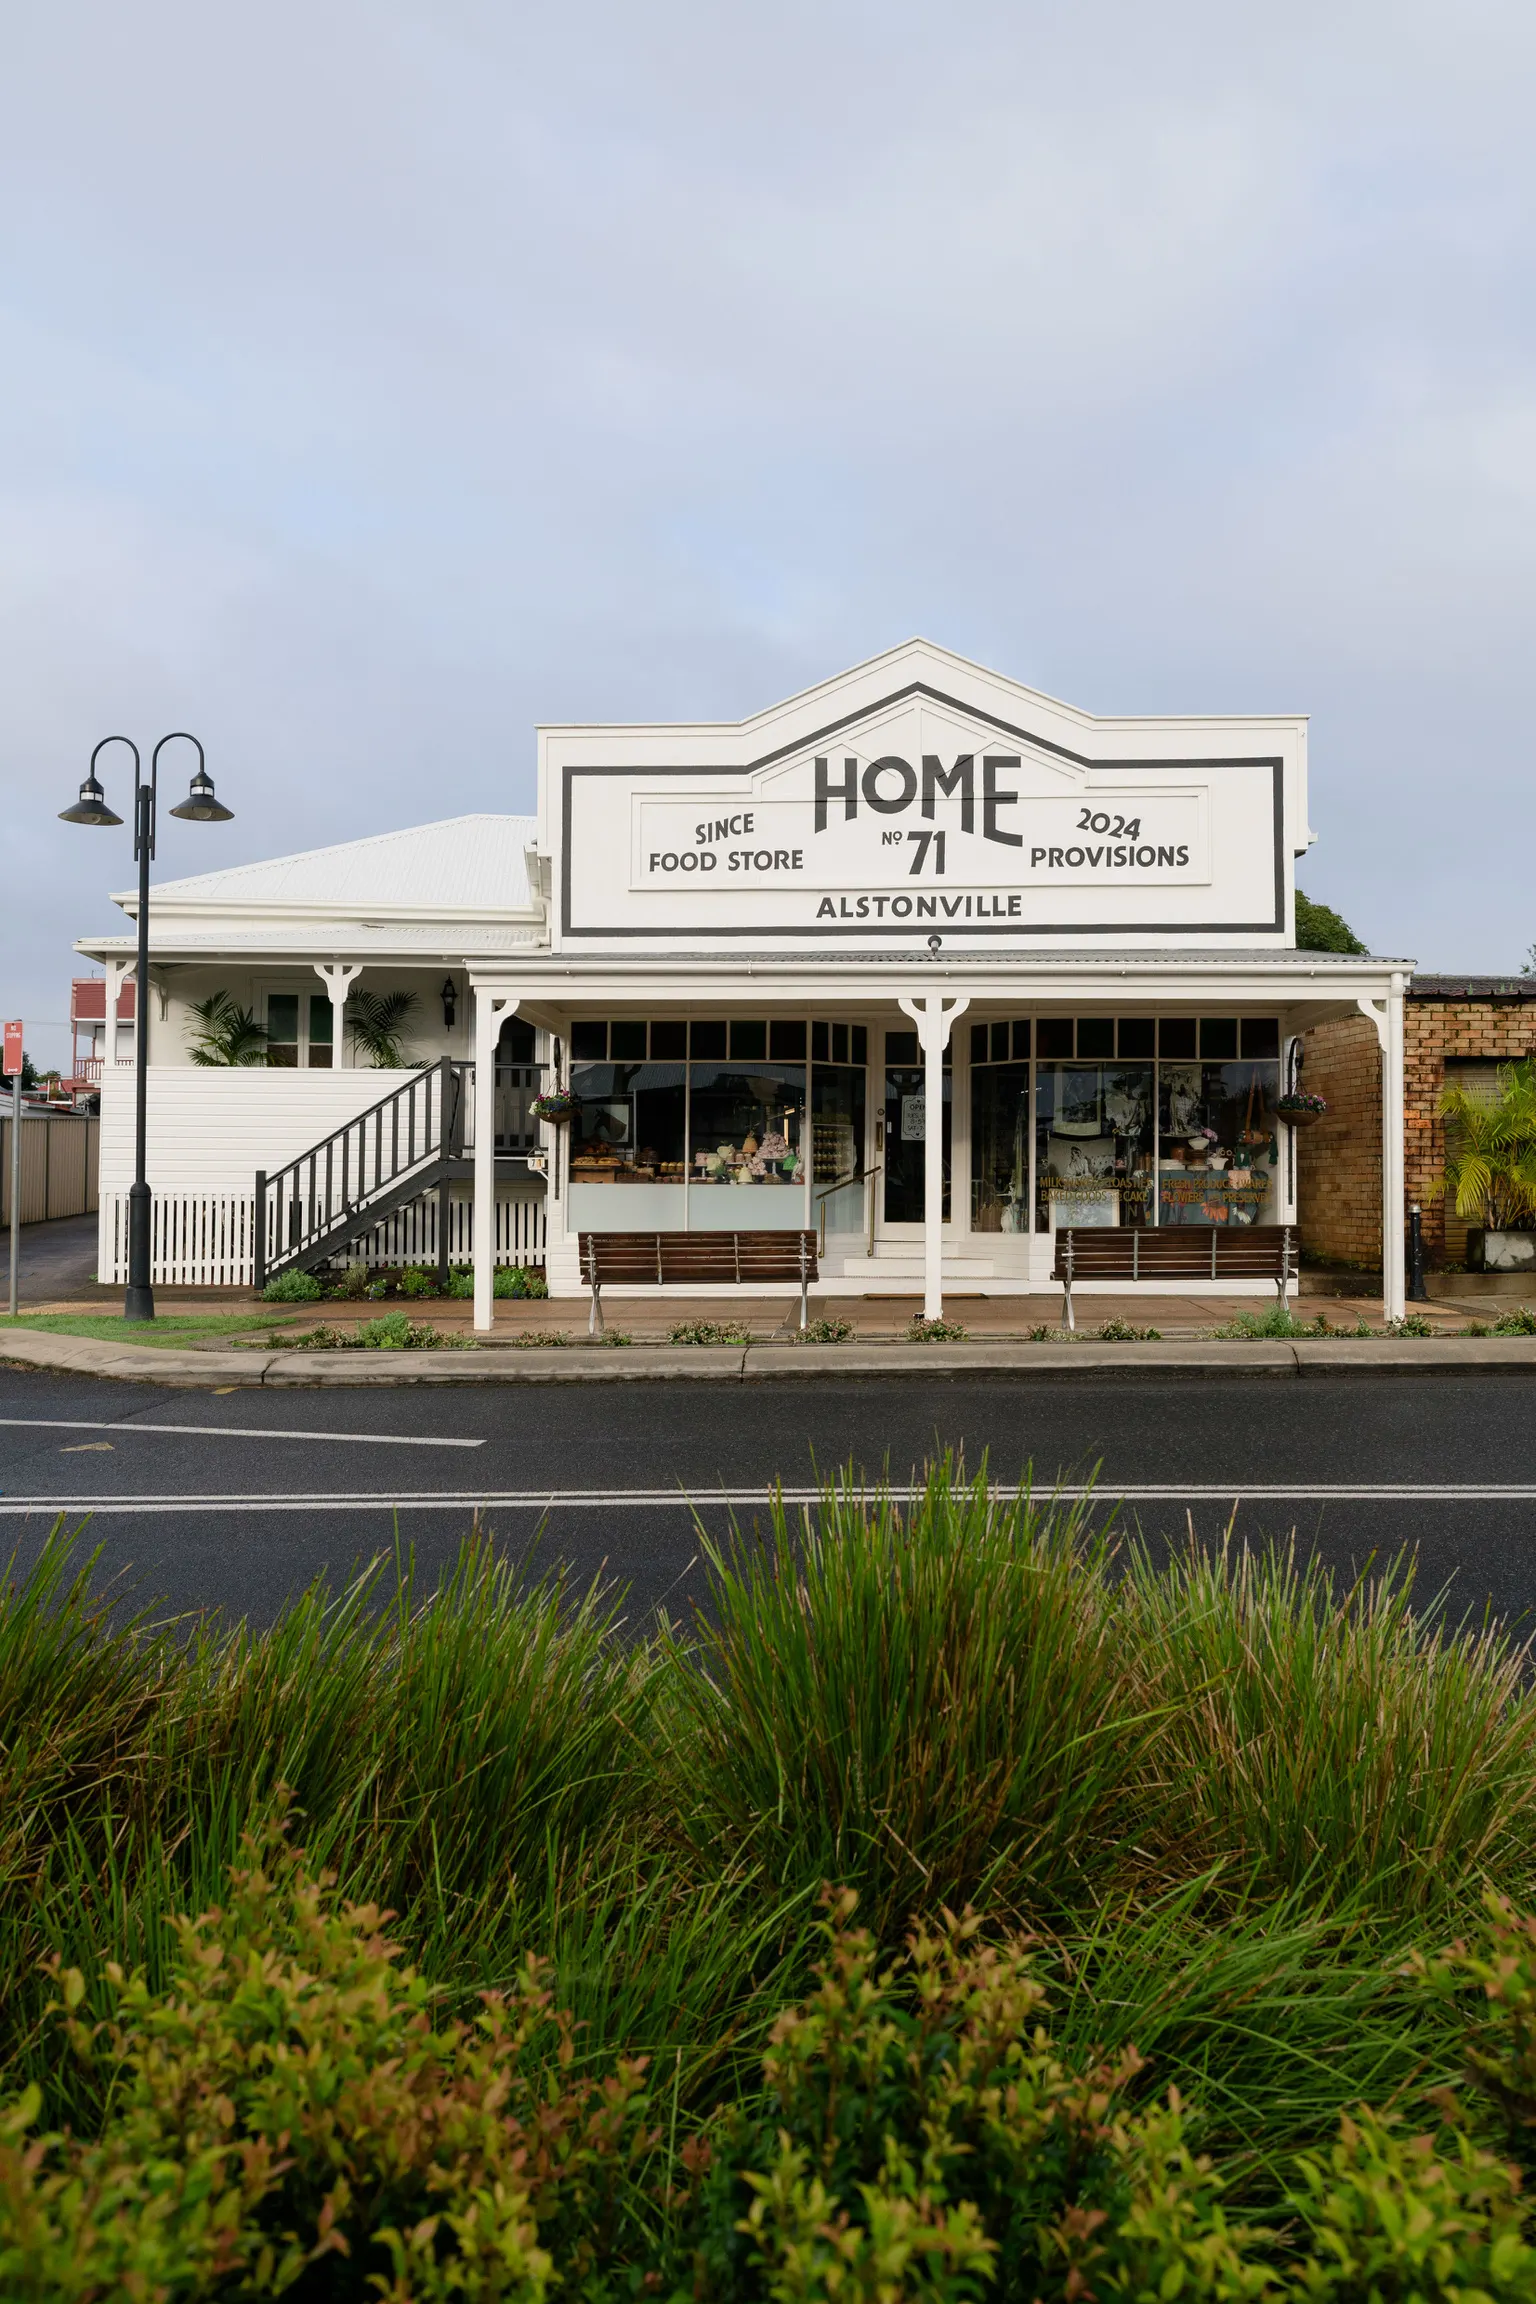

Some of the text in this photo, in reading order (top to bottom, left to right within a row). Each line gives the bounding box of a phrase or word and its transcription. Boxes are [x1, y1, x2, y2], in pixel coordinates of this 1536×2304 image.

[814, 755, 1022, 847] HOME
[696, 813, 753, 844] SINCE
[1076, 808, 1141, 842] 2024
[649, 850, 804, 872] FOOD STORE
[907, 830, 946, 875] 71
[1031, 846, 1190, 868] PROVISIONS
[816, 896, 1022, 918] ALSTONVILLE
[1041, 1190, 1073, 1201] BAKED
[1074, 1190, 1107, 1201] GOODS
